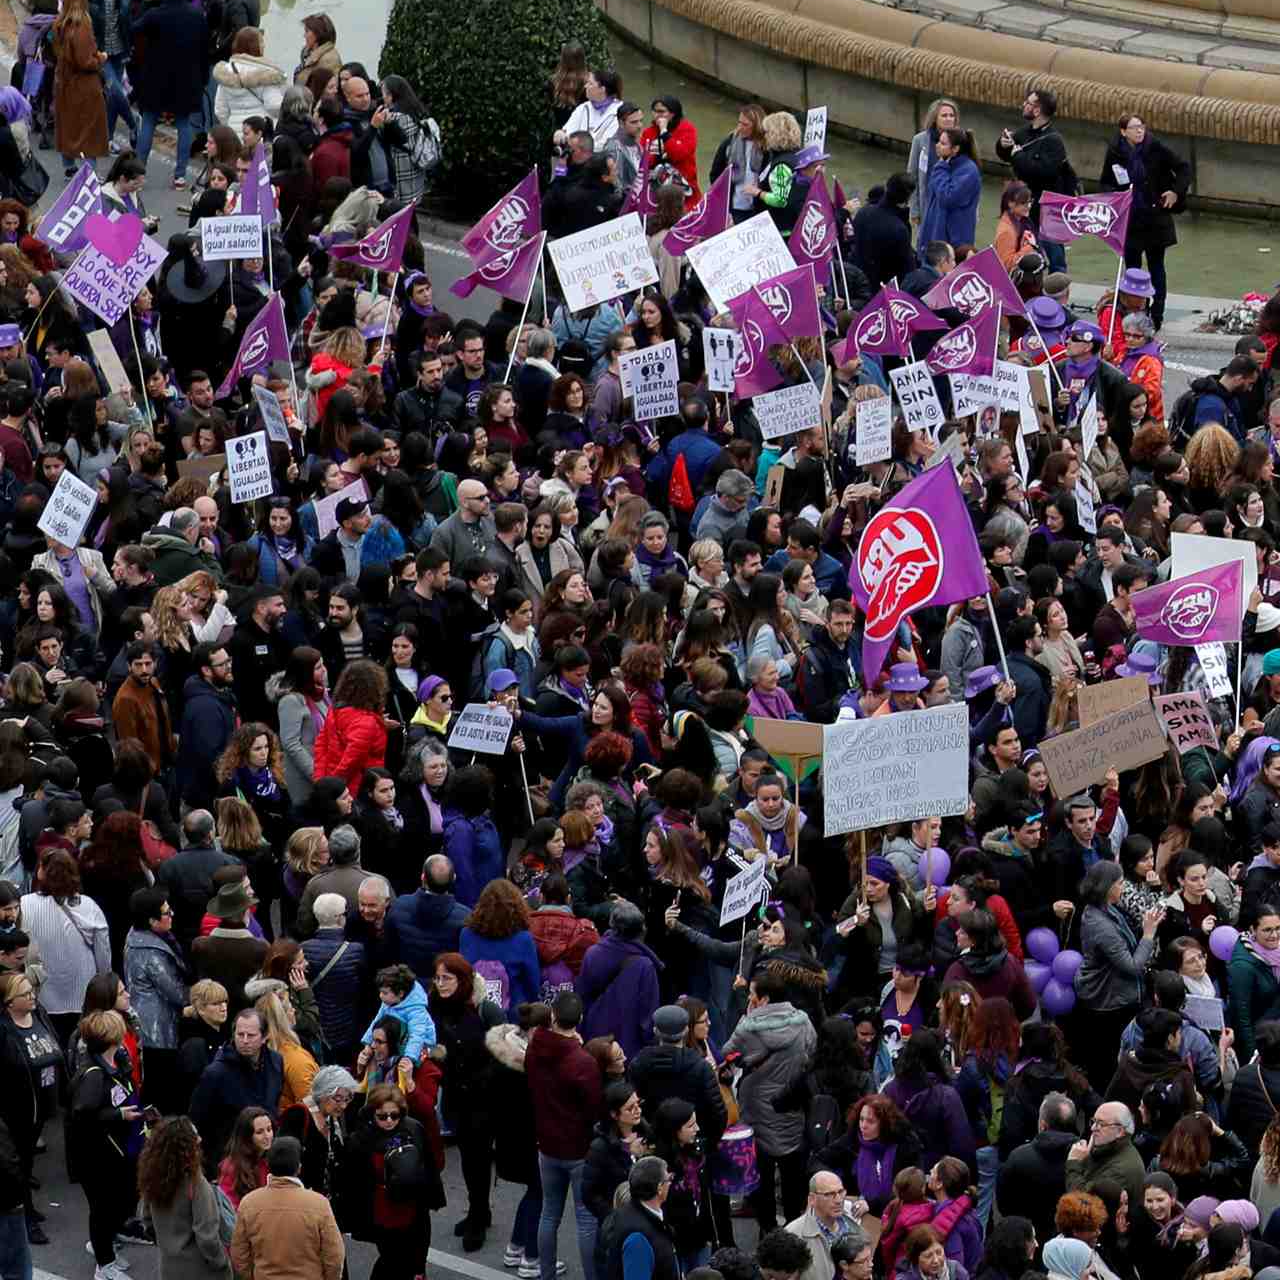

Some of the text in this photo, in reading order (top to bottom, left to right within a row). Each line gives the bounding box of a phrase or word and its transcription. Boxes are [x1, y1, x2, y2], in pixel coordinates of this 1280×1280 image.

[214, 224, 232, 237] igual
[205, 239, 226, 251] igual
[78, 255, 95, 272] LO
[94, 267, 116, 293] QUE
[65, 272, 101, 306] QUIERA
[895, 370, 928, 389] AMA
[902, 386, 935, 407] SIN
[1162, 699, 1202, 715] AMA
[895, 712, 967, 736] MINUTO
[1168, 715, 1207, 730] SIN
